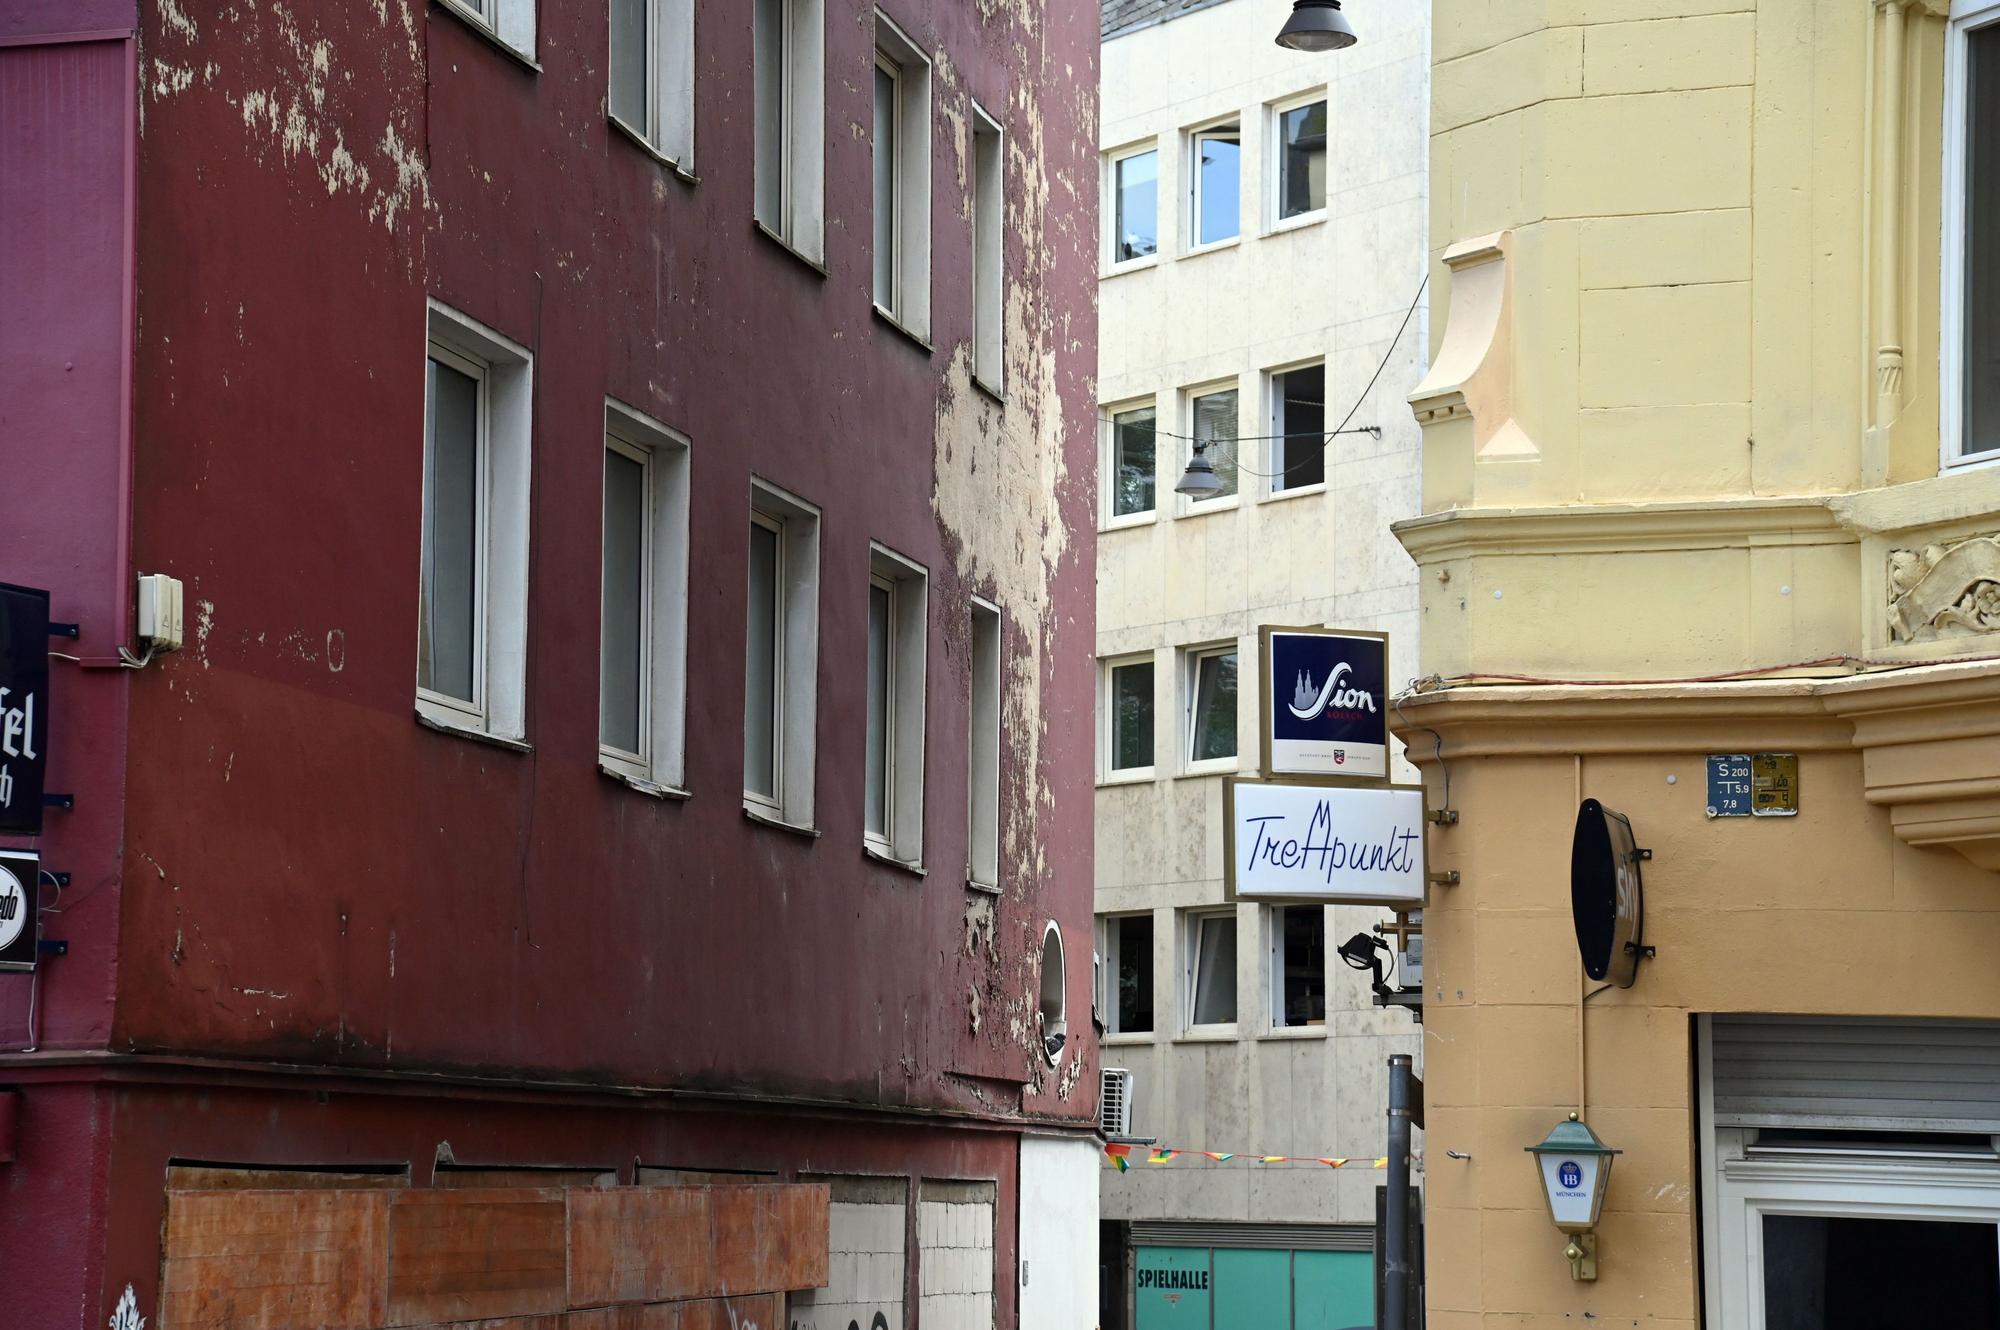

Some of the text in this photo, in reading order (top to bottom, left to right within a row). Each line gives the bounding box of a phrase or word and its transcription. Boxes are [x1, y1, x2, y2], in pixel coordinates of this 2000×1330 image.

[1288, 662, 1377, 721] Sion
[1731, 768, 1749, 777] 200
[1564, 1174, 1578, 1185] HB
[1138, 1269, 1208, 1290] SPIELHALLE
